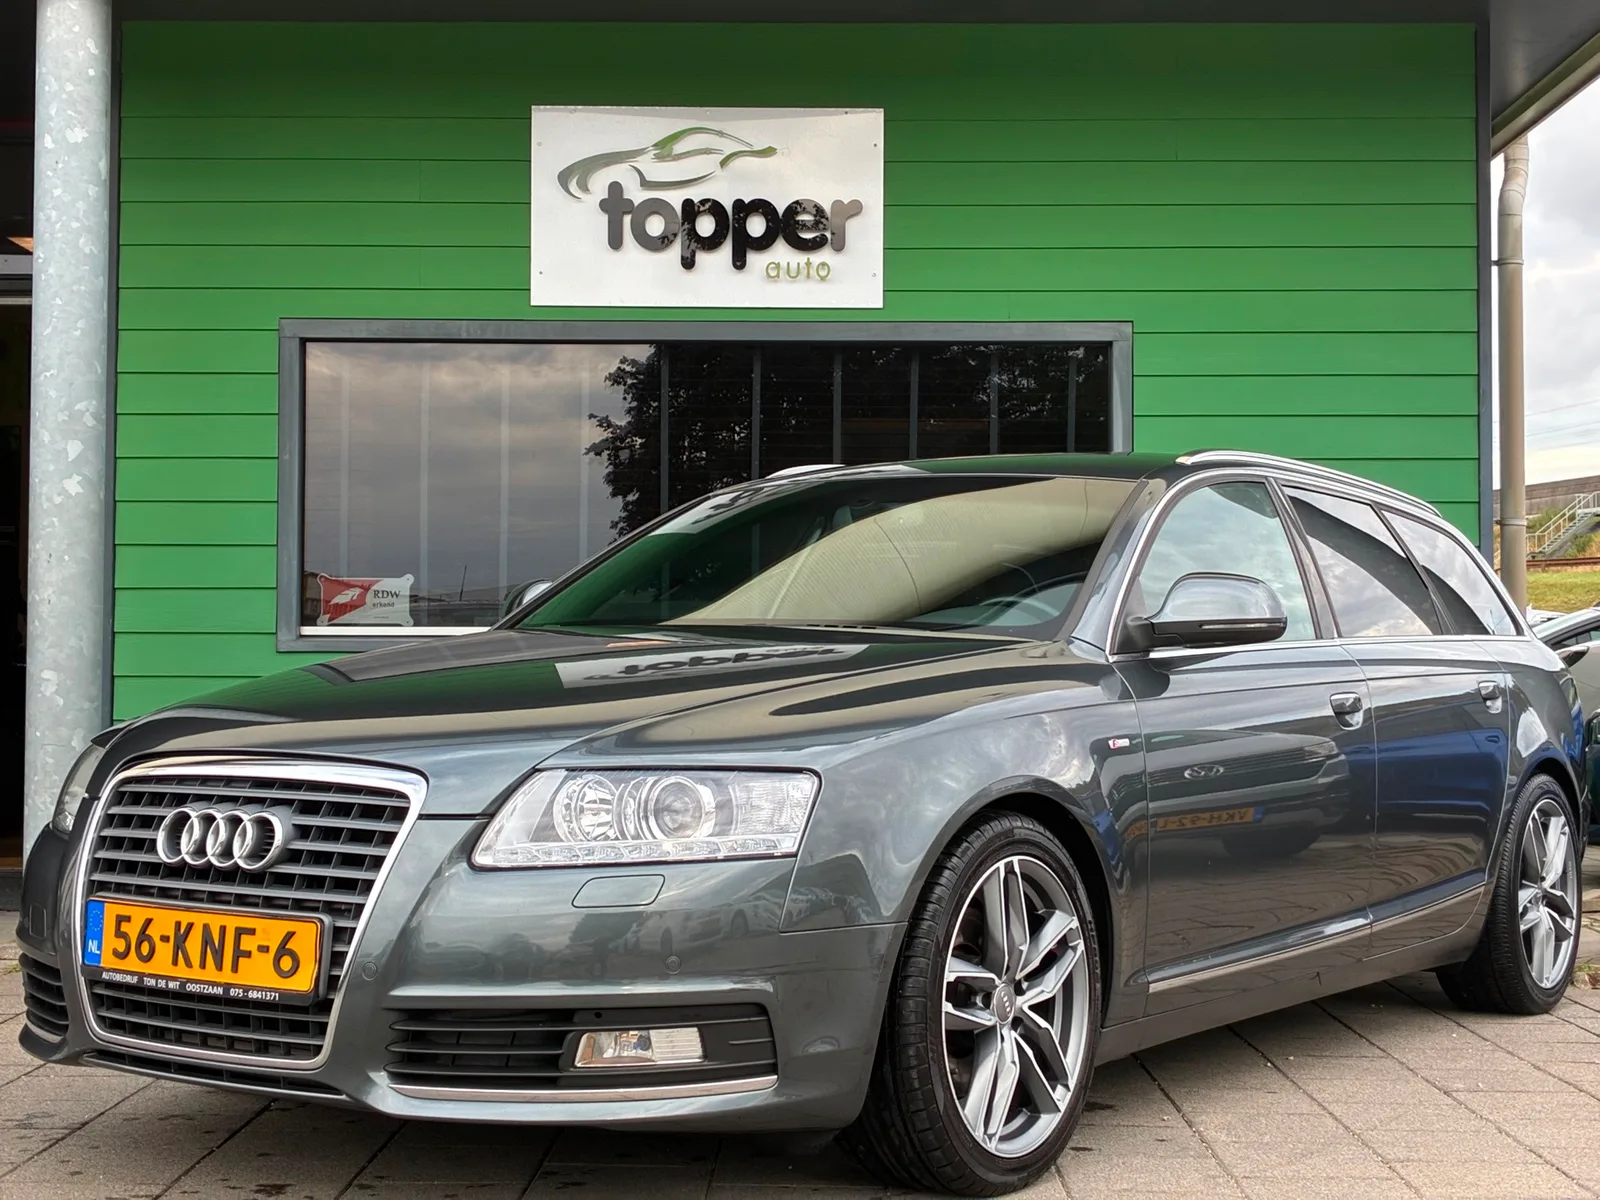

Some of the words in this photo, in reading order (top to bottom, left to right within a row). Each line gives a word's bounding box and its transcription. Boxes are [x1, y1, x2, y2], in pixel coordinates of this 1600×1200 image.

[599, 181, 863, 270] topper
[765, 257, 831, 281] auto
[373, 590, 401, 599] RDW
[88, 939, 100, 954] NL
[112, 913, 301, 979] 56-KNF-6
[102, 971, 138, 984] AUTOBEDRIJF
[143, 977, 156, 987] TON
[158, 979, 166, 988] DE
[168, 981, 180, 990] WIT
[185, 982, 223, 995] OOSTZAAN
